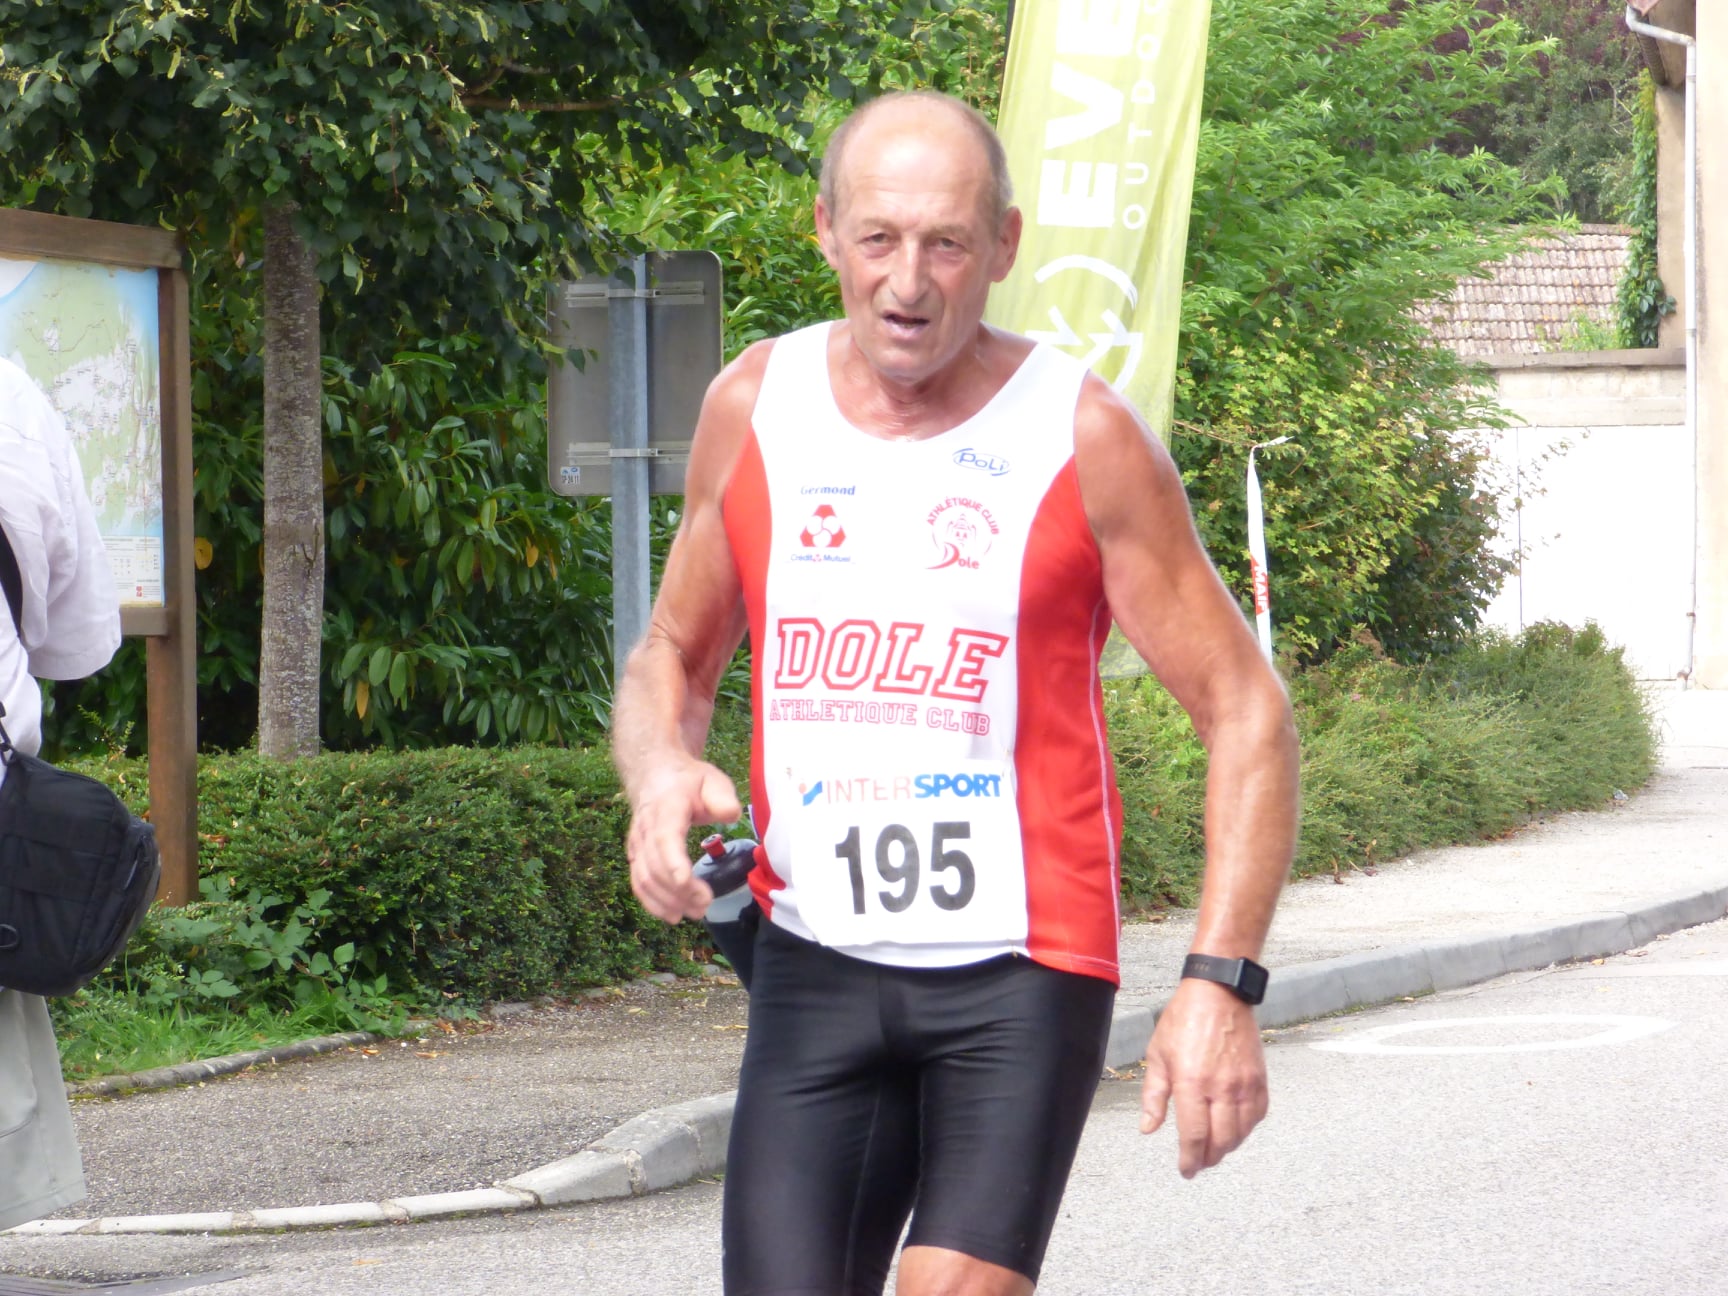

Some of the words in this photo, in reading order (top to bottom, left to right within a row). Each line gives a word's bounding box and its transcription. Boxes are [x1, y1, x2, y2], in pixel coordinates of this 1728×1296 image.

[800, 484, 856, 496] Germond
[981, 508, 1000, 535] CLUB
[924, 542, 980, 569] Dole
[774, 617, 1010, 703] DOLE
[769, 698, 917, 725] ATHLETIQUE
[926, 707, 990, 736] CLUB
[826, 773, 1001, 804] INTERSPORT
[835, 821, 976, 915] 195
